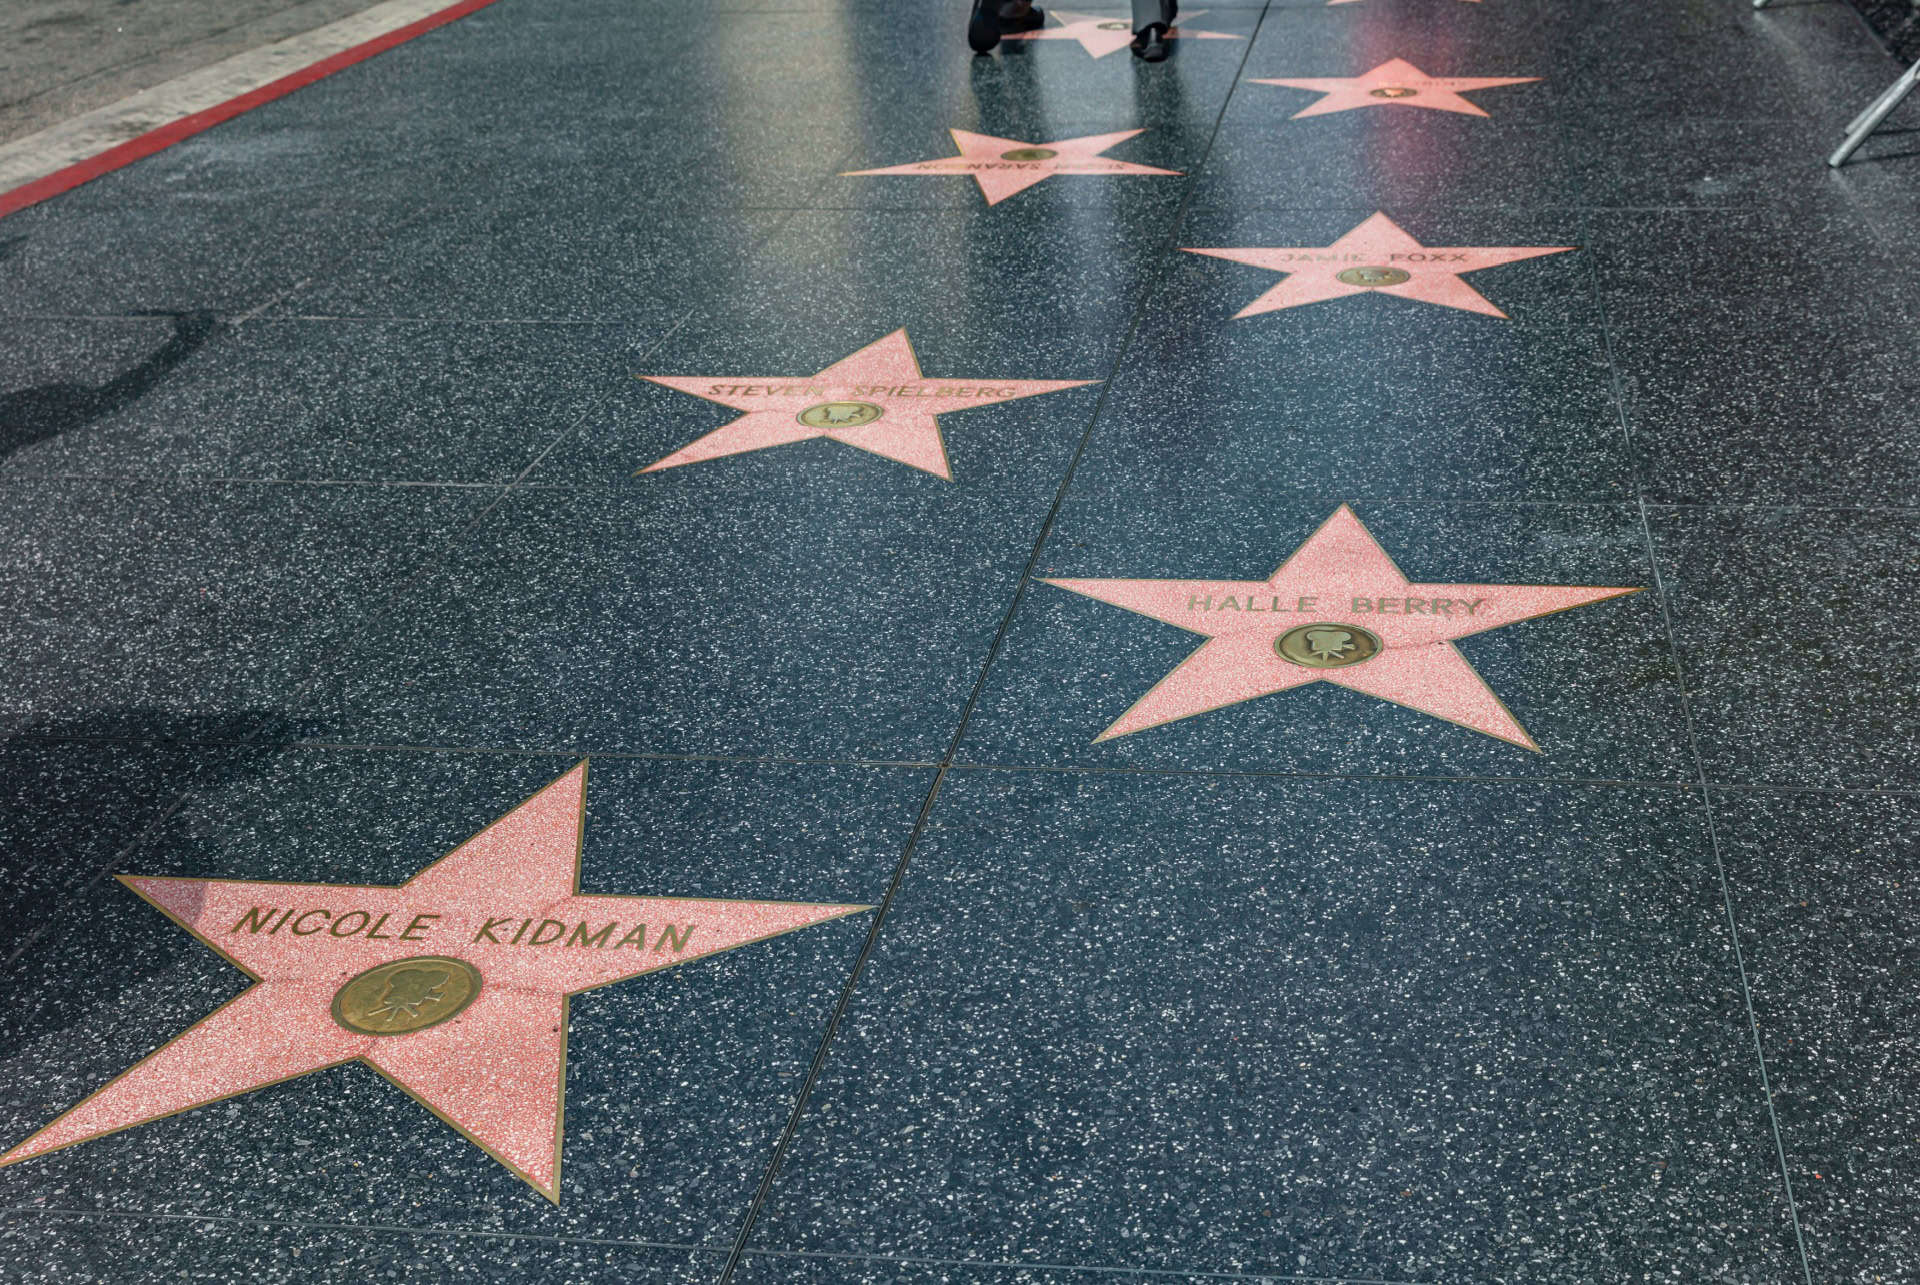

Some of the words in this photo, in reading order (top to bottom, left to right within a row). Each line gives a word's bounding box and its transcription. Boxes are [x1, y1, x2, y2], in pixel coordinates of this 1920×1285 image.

[1389, 253, 1467, 263] FOXX
[708, 384, 825, 397] STEVEN
[854, 385, 1017, 399] SPIELBERG
[1187, 595, 1320, 612] HALLE
[1350, 597, 1488, 615] BERRY
[232, 907, 441, 942] NICOLE
[473, 917, 697, 953] KIDMAN
